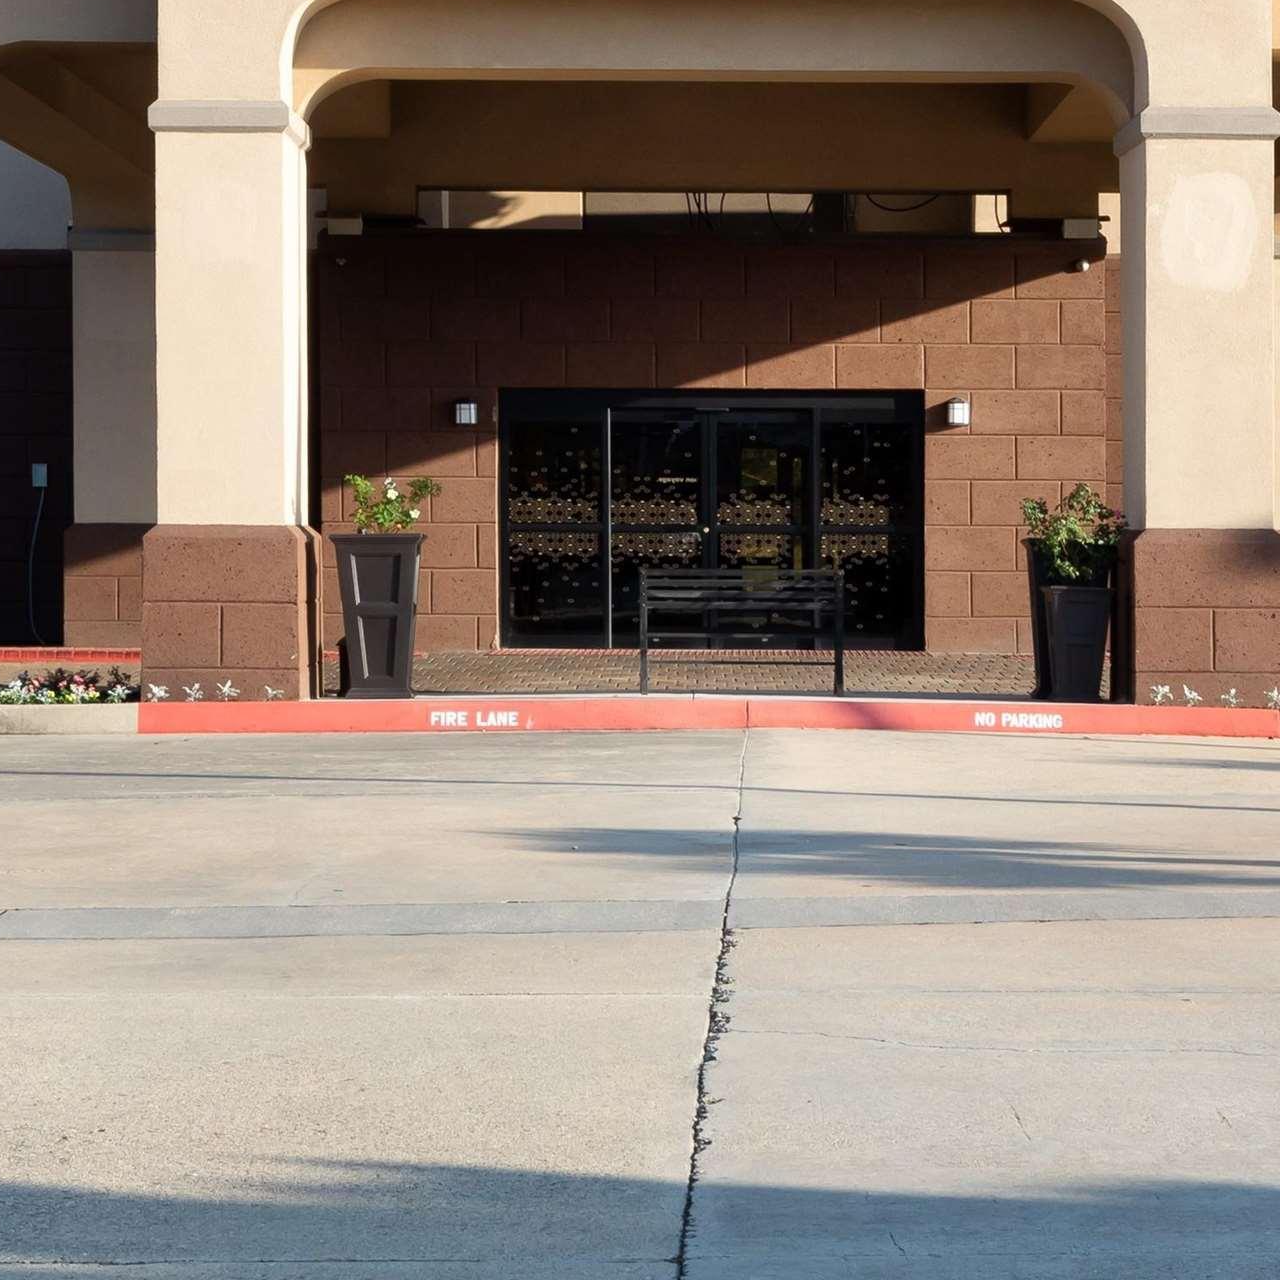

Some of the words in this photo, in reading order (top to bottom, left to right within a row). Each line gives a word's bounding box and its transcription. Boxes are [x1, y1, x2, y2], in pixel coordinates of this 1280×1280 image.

[430, 711, 468, 727] FIRE
[476, 711, 519, 727] LANE
[974, 712, 996, 727] NO
[1001, 712, 1063, 728] PARKING
